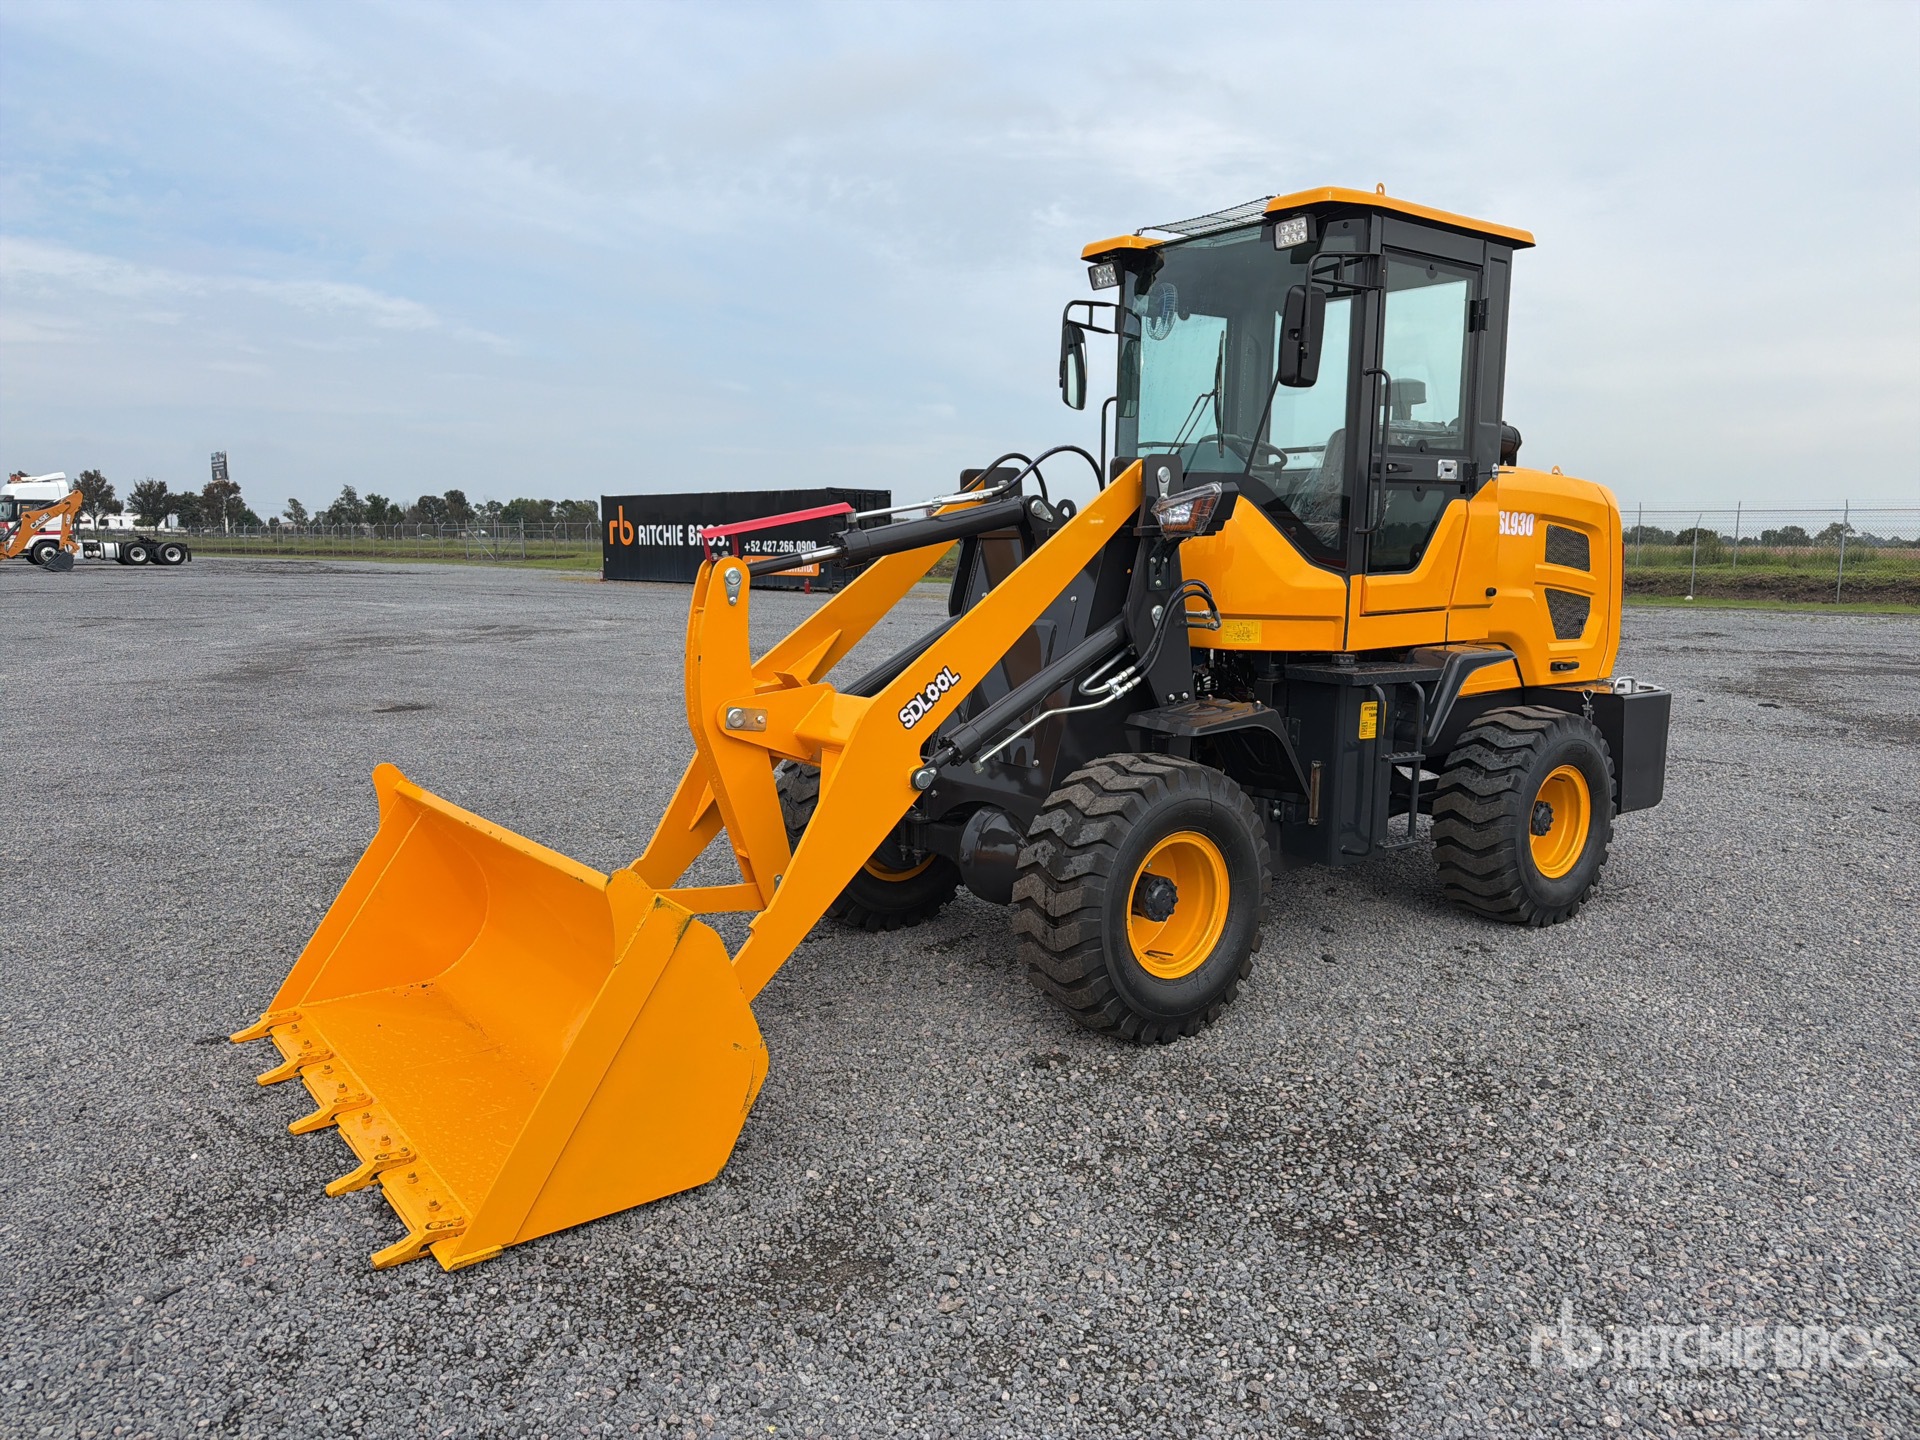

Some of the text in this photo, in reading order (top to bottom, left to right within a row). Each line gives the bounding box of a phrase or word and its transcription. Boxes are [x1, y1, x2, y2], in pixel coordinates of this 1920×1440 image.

[30, 513, 50, 529] CASE
[609, 505, 634, 545] rb
[638, 525, 683, 546] RITCHIE
[1499, 511, 1534, 536] SL930
[744, 540, 817, 552] +52 427.266.0909
